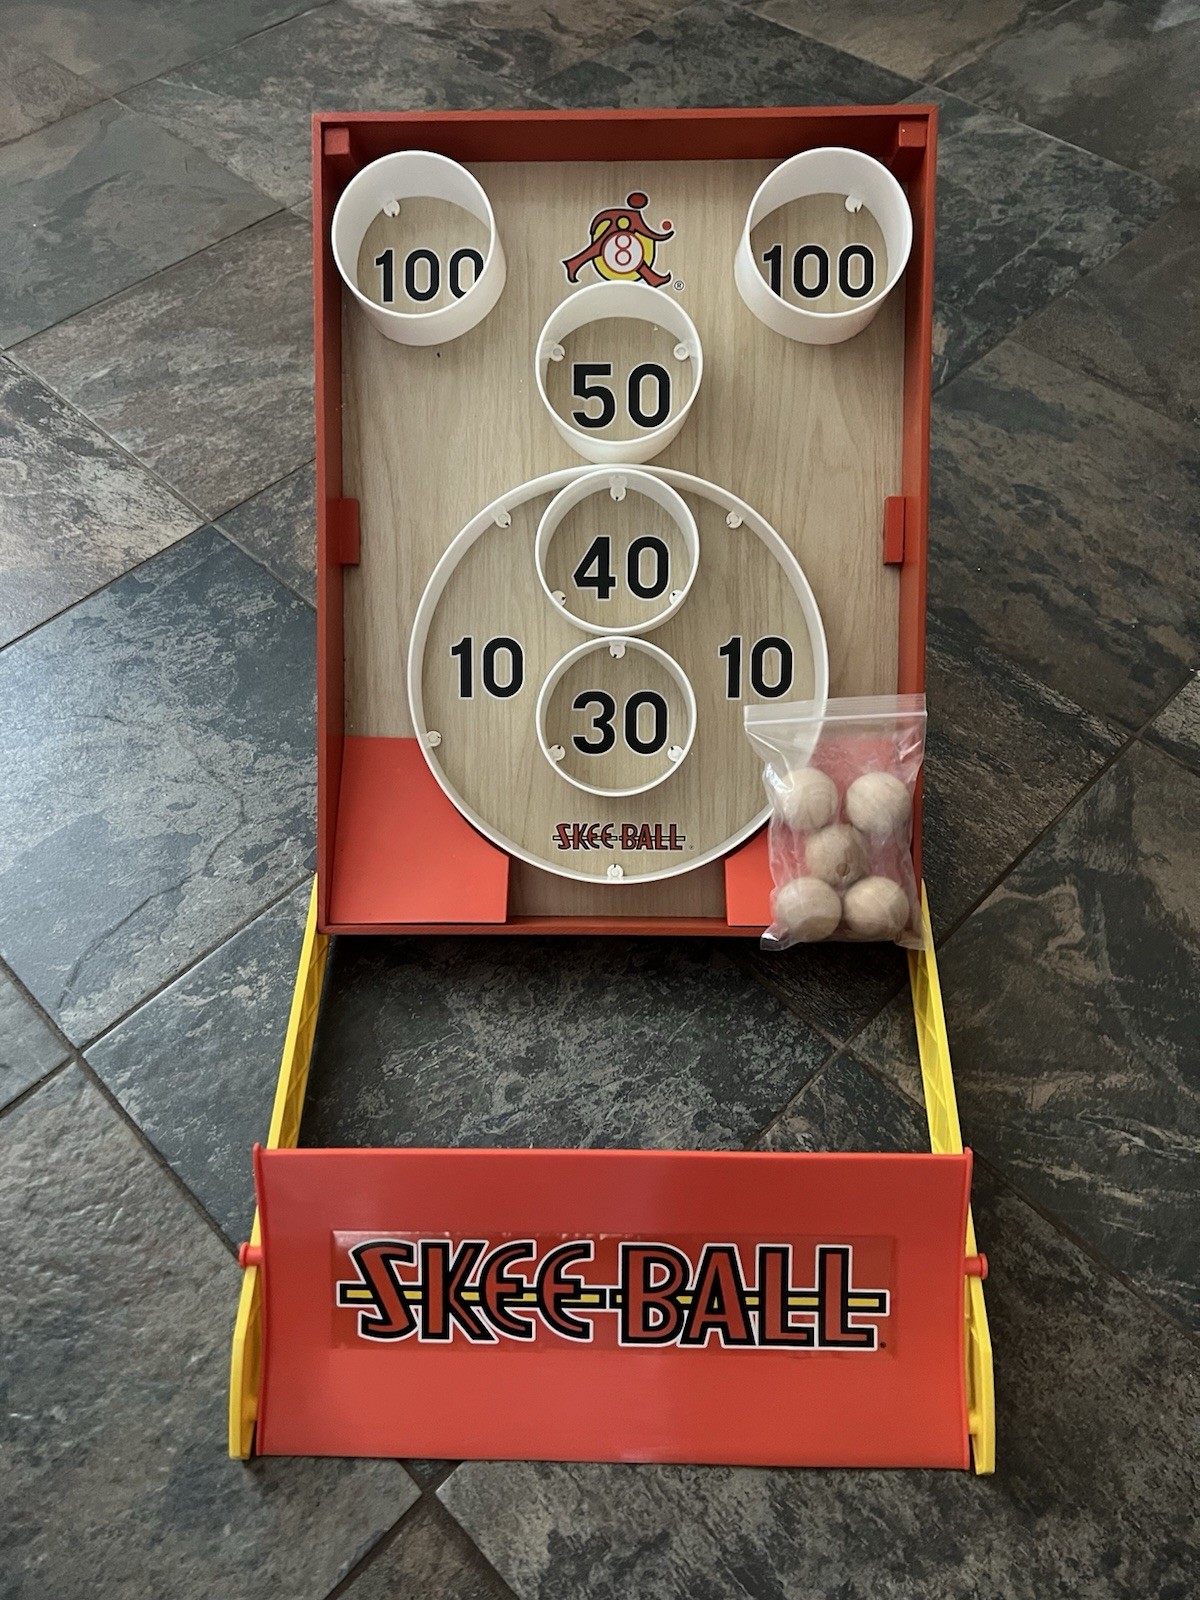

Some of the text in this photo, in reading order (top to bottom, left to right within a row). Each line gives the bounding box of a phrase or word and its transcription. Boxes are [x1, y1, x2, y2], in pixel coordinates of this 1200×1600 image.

[375, 247, 485, 303] 100
[614, 233, 632, 265] 8
[762, 244, 875, 299] 100
[572, 363, 671, 429] 50
[573, 536, 669, 600] 40
[451, 636, 524, 699] 10
[719, 636, 793, 699] 10
[572, 691, 668, 755] 30
